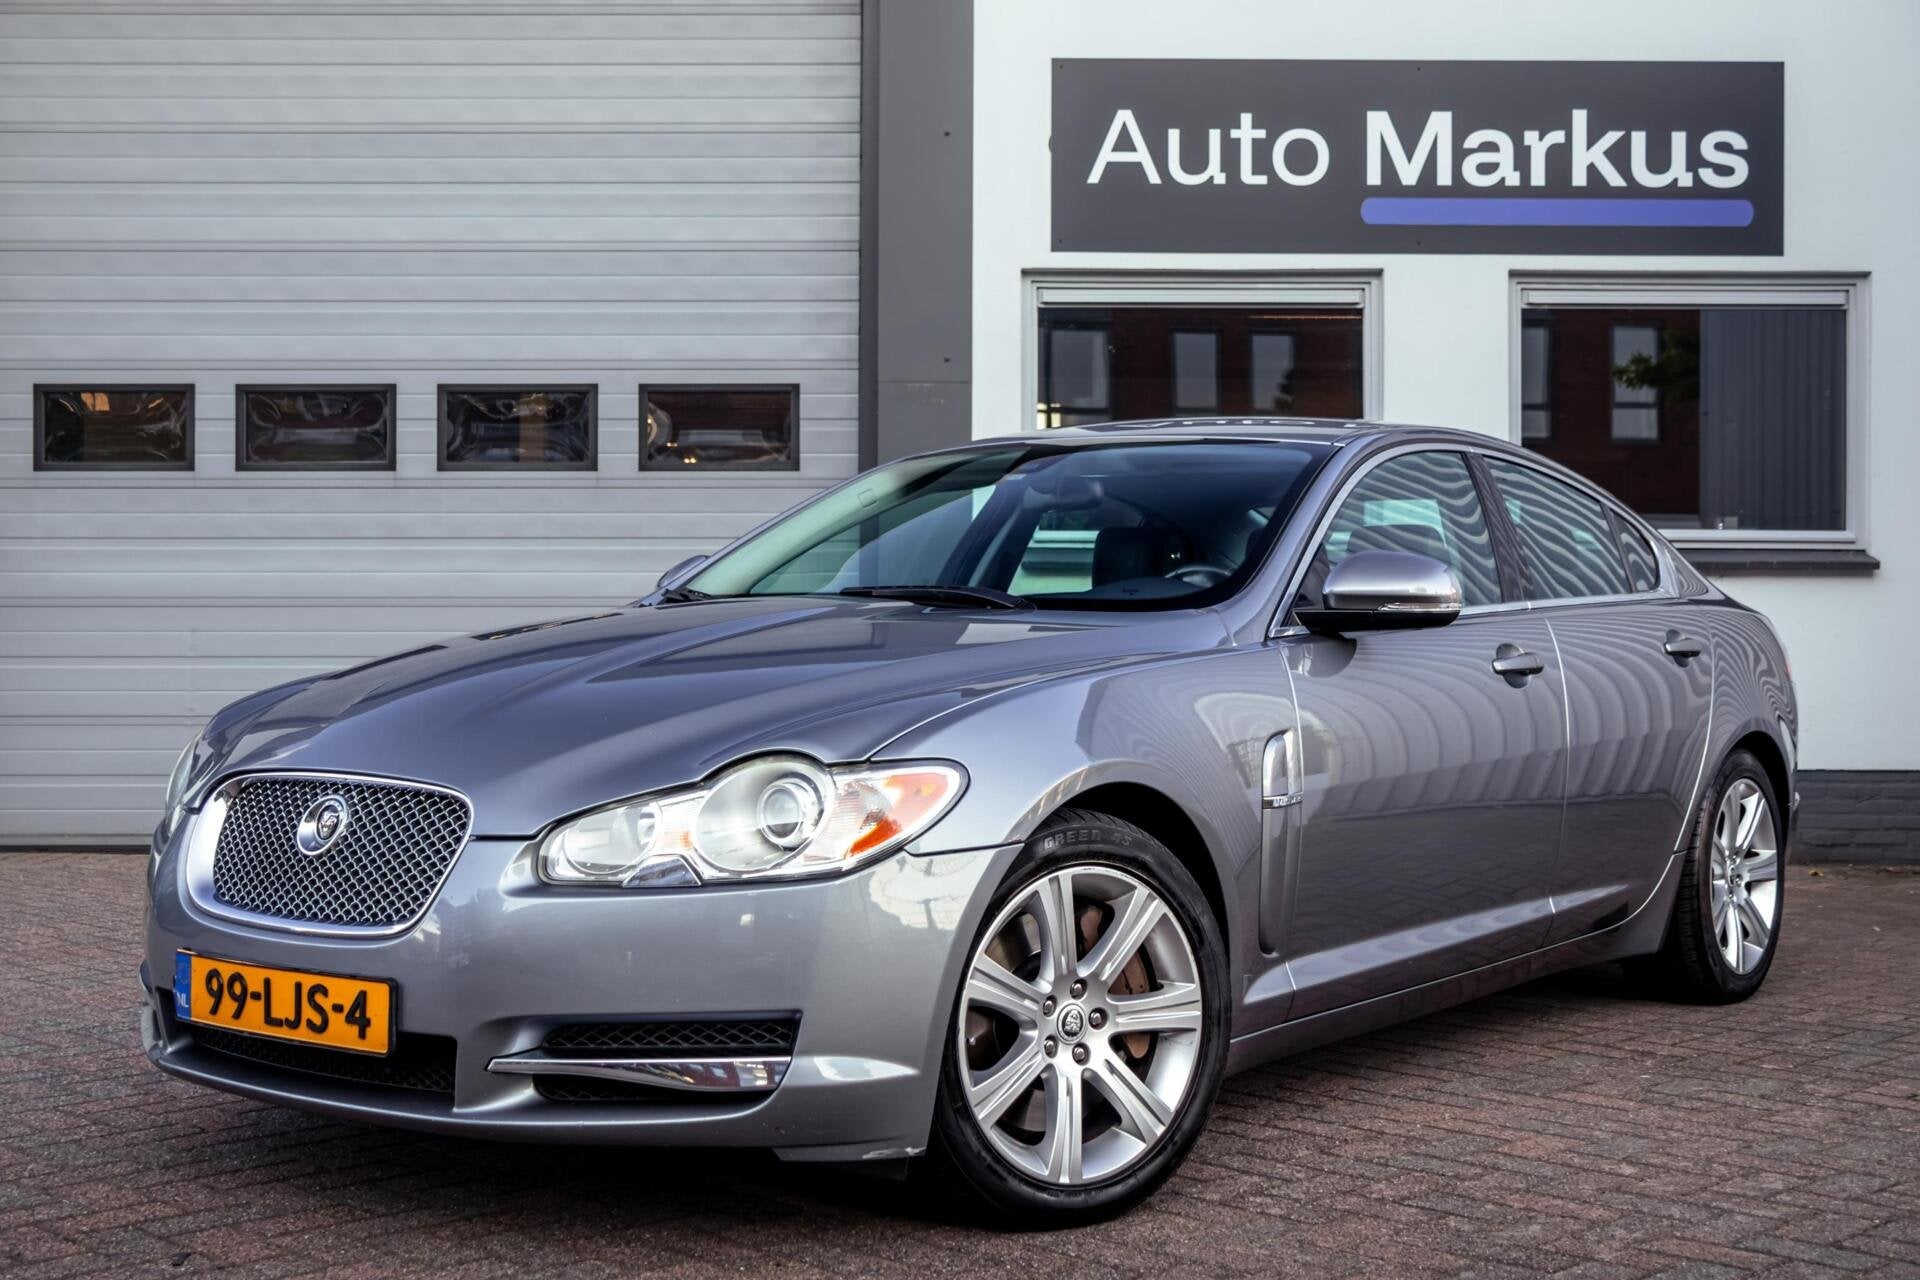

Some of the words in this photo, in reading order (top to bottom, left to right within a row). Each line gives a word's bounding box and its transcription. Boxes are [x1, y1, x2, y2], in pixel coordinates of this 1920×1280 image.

[1086, 108, 1331, 187] Auto
[1365, 109, 1751, 188] Markus
[175, 991, 190, 1008] NL
[205, 967, 371, 1040] 99-LJS-4
